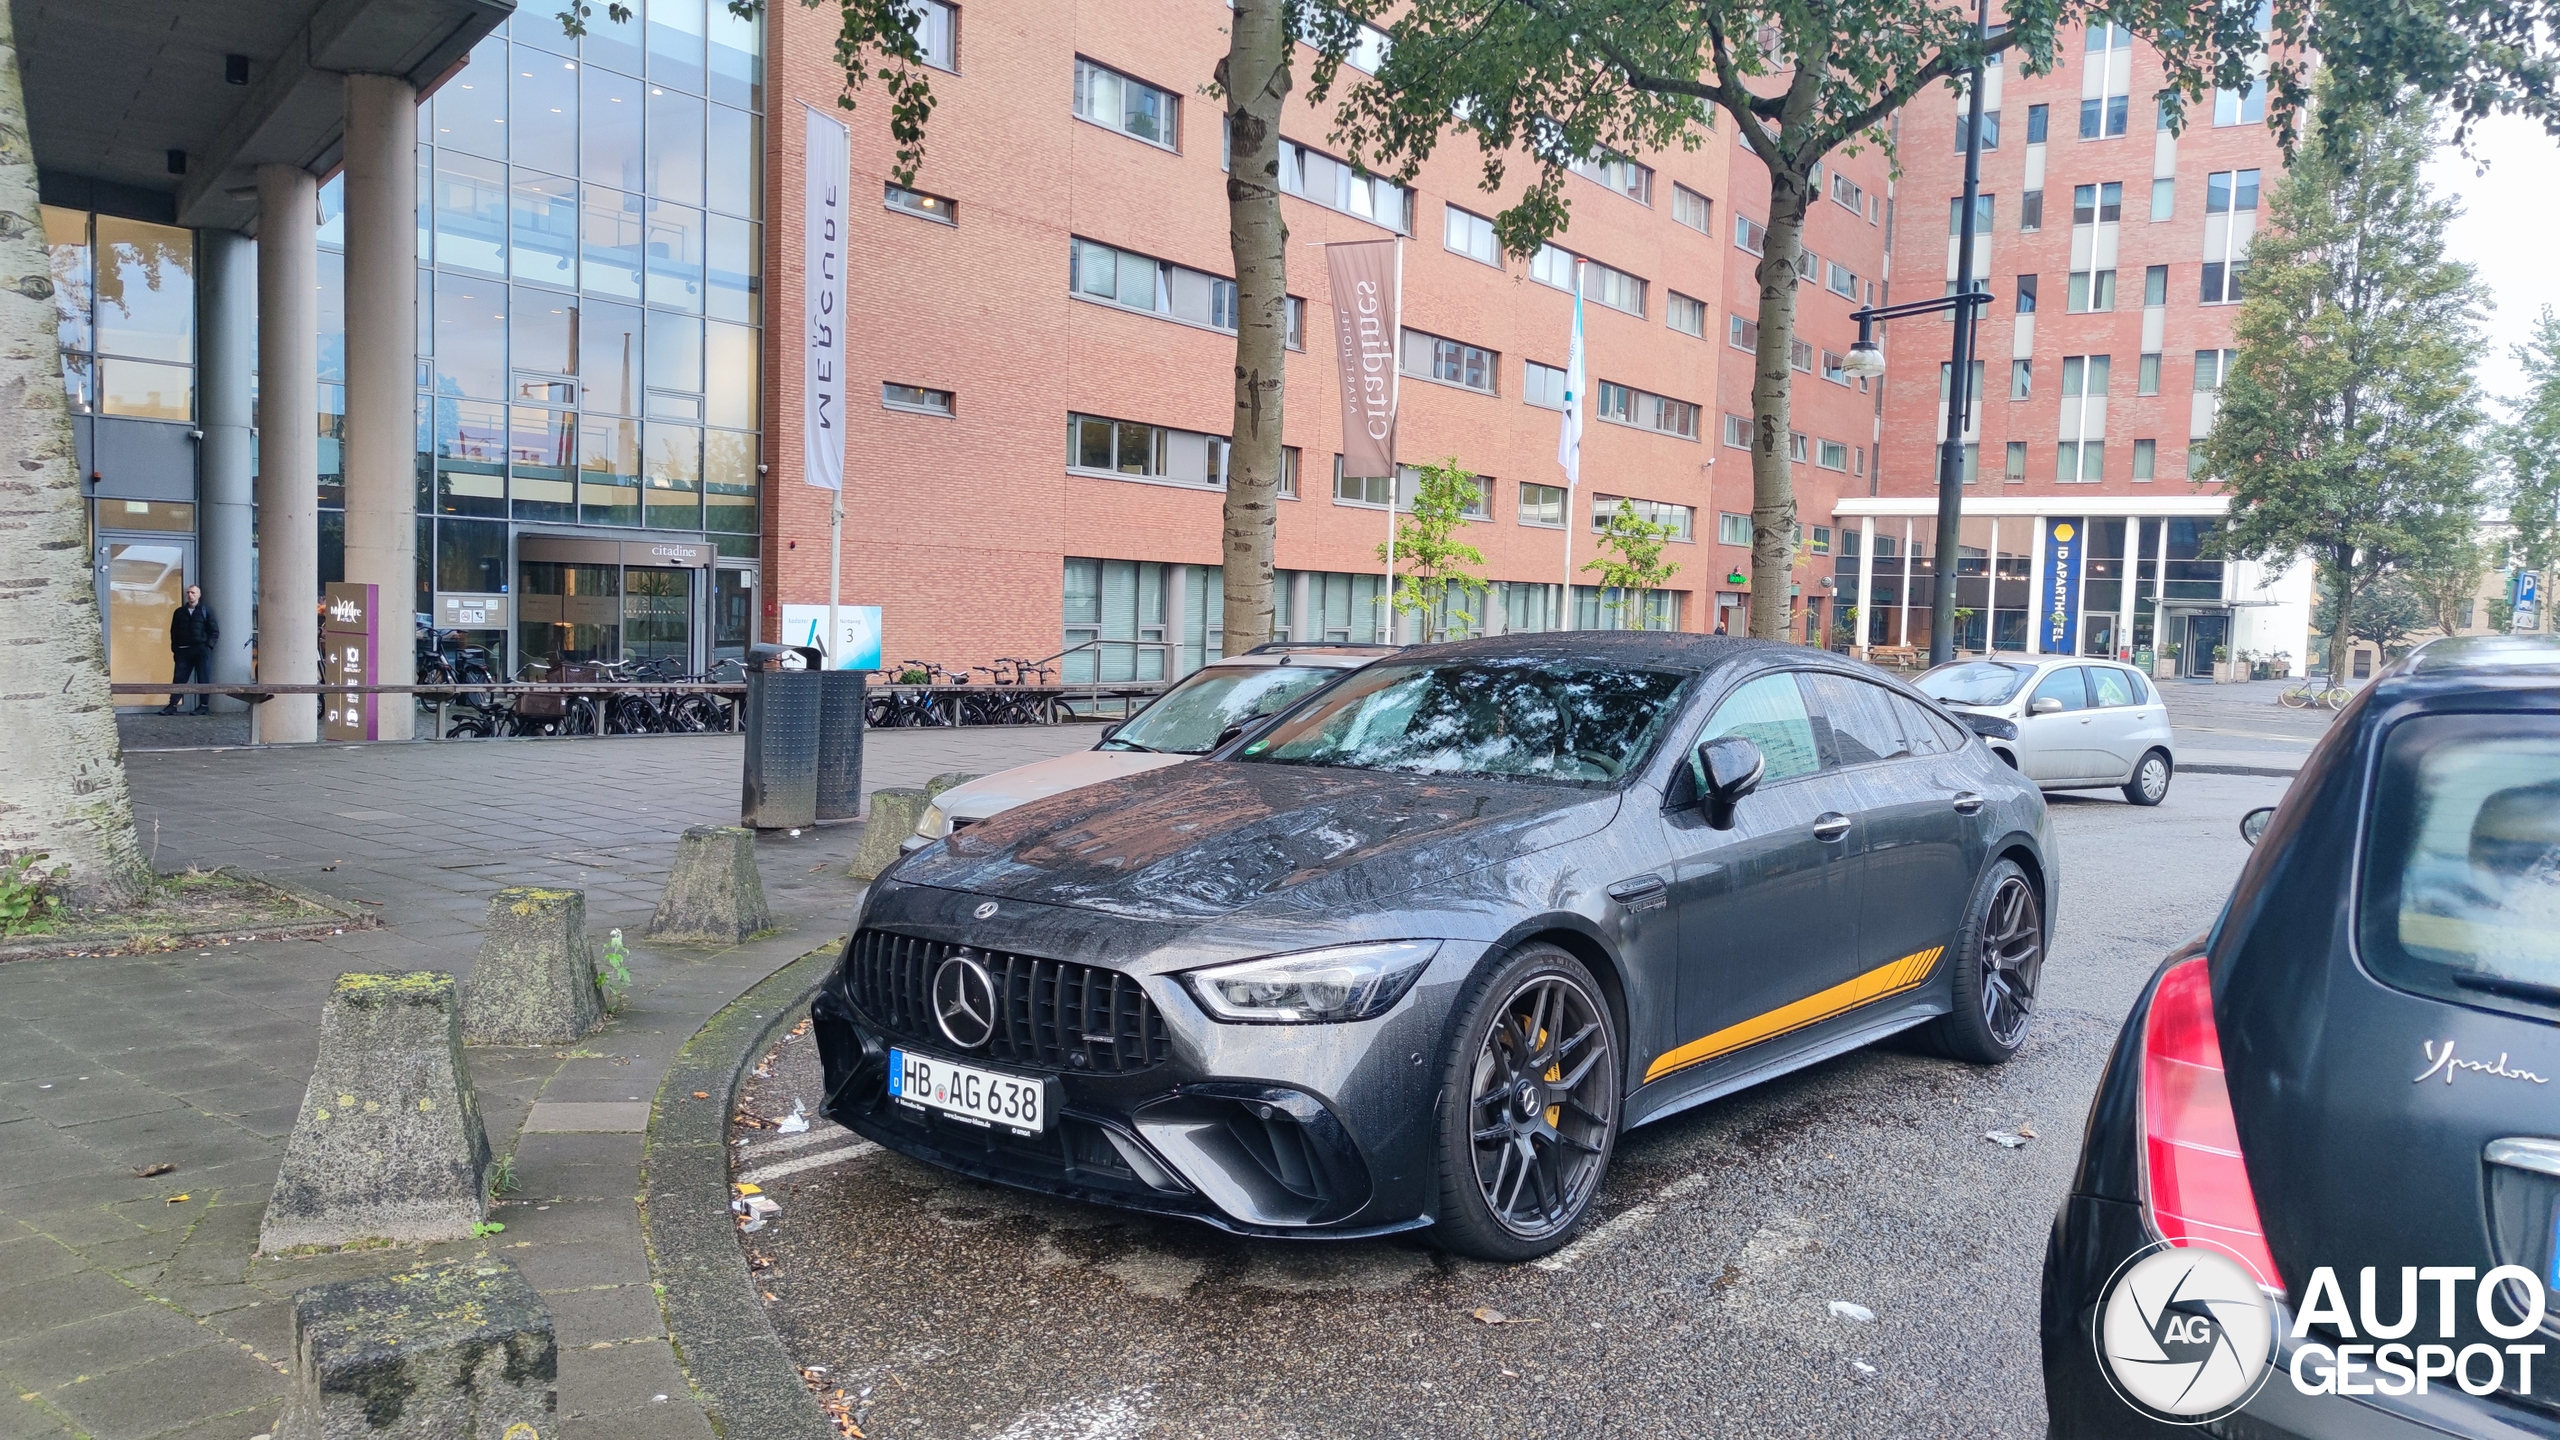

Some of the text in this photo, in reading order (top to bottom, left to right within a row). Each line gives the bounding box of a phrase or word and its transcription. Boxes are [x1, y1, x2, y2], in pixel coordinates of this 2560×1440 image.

[652, 545, 697, 557] citadines
[2057, 546, 2069, 559] ID
[2522, 576, 2534, 596] P
[845, 628, 854, 643] 3
[2413, 1040, 2549, 1084] Ypsilon
[904, 1058, 931, 1097] HB
[949, 1071, 980, 1110] AG
[987, 1080, 1037, 1122] 638
